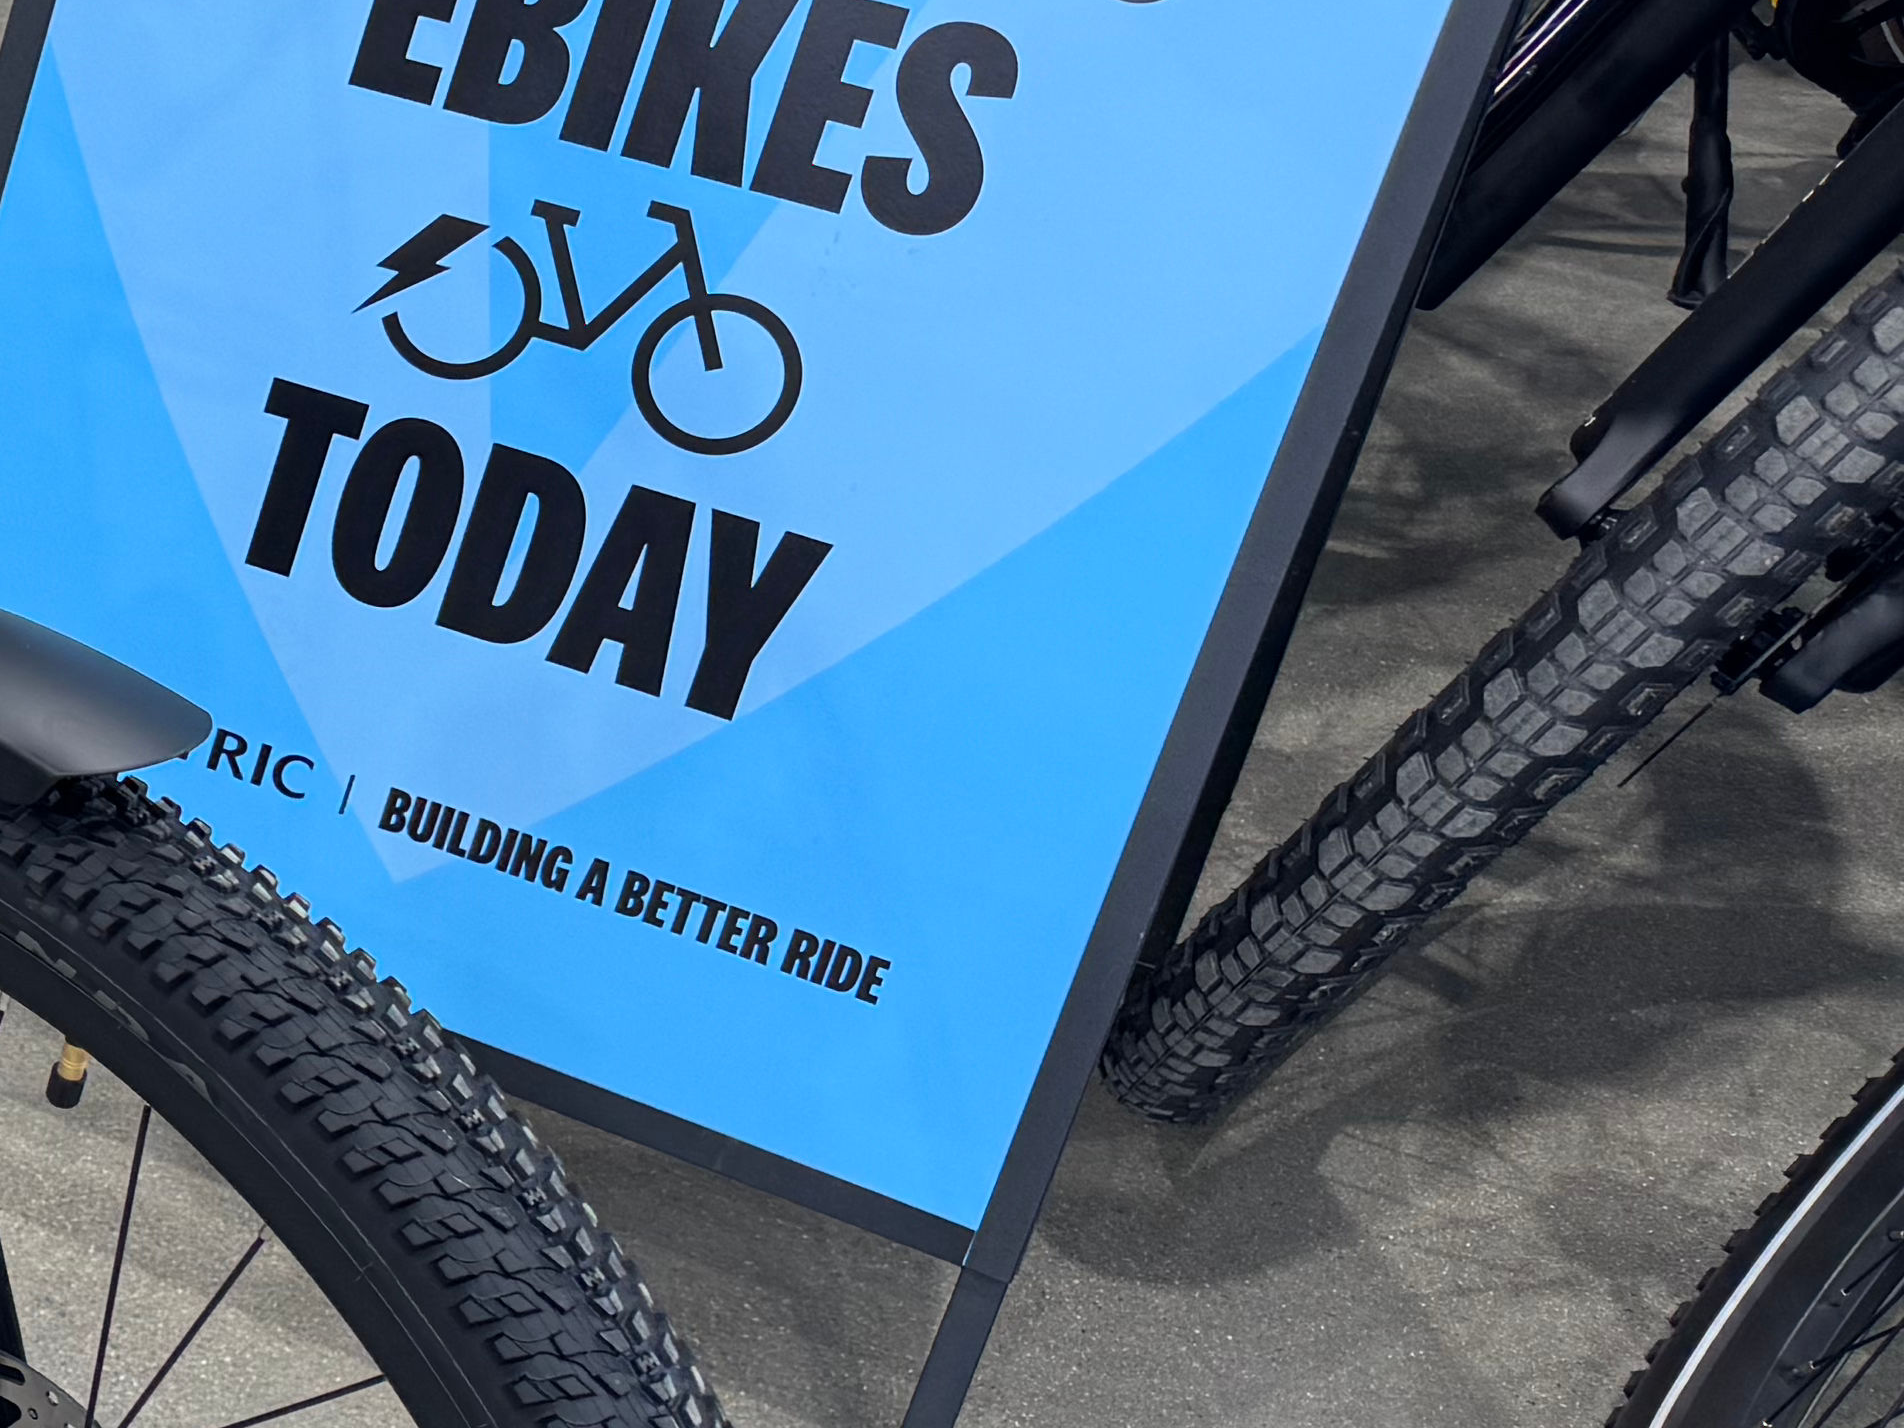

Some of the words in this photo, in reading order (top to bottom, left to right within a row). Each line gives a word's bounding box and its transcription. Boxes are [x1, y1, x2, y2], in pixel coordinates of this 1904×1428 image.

[245, 378, 834, 722] TODAY
[178, 729, 315, 800] RIC
[379, 788, 574, 893] BUILDING
[575, 858, 610, 907] A
[615, 870, 778, 966] BETTER
[781, 928, 891, 1006] RIDE
